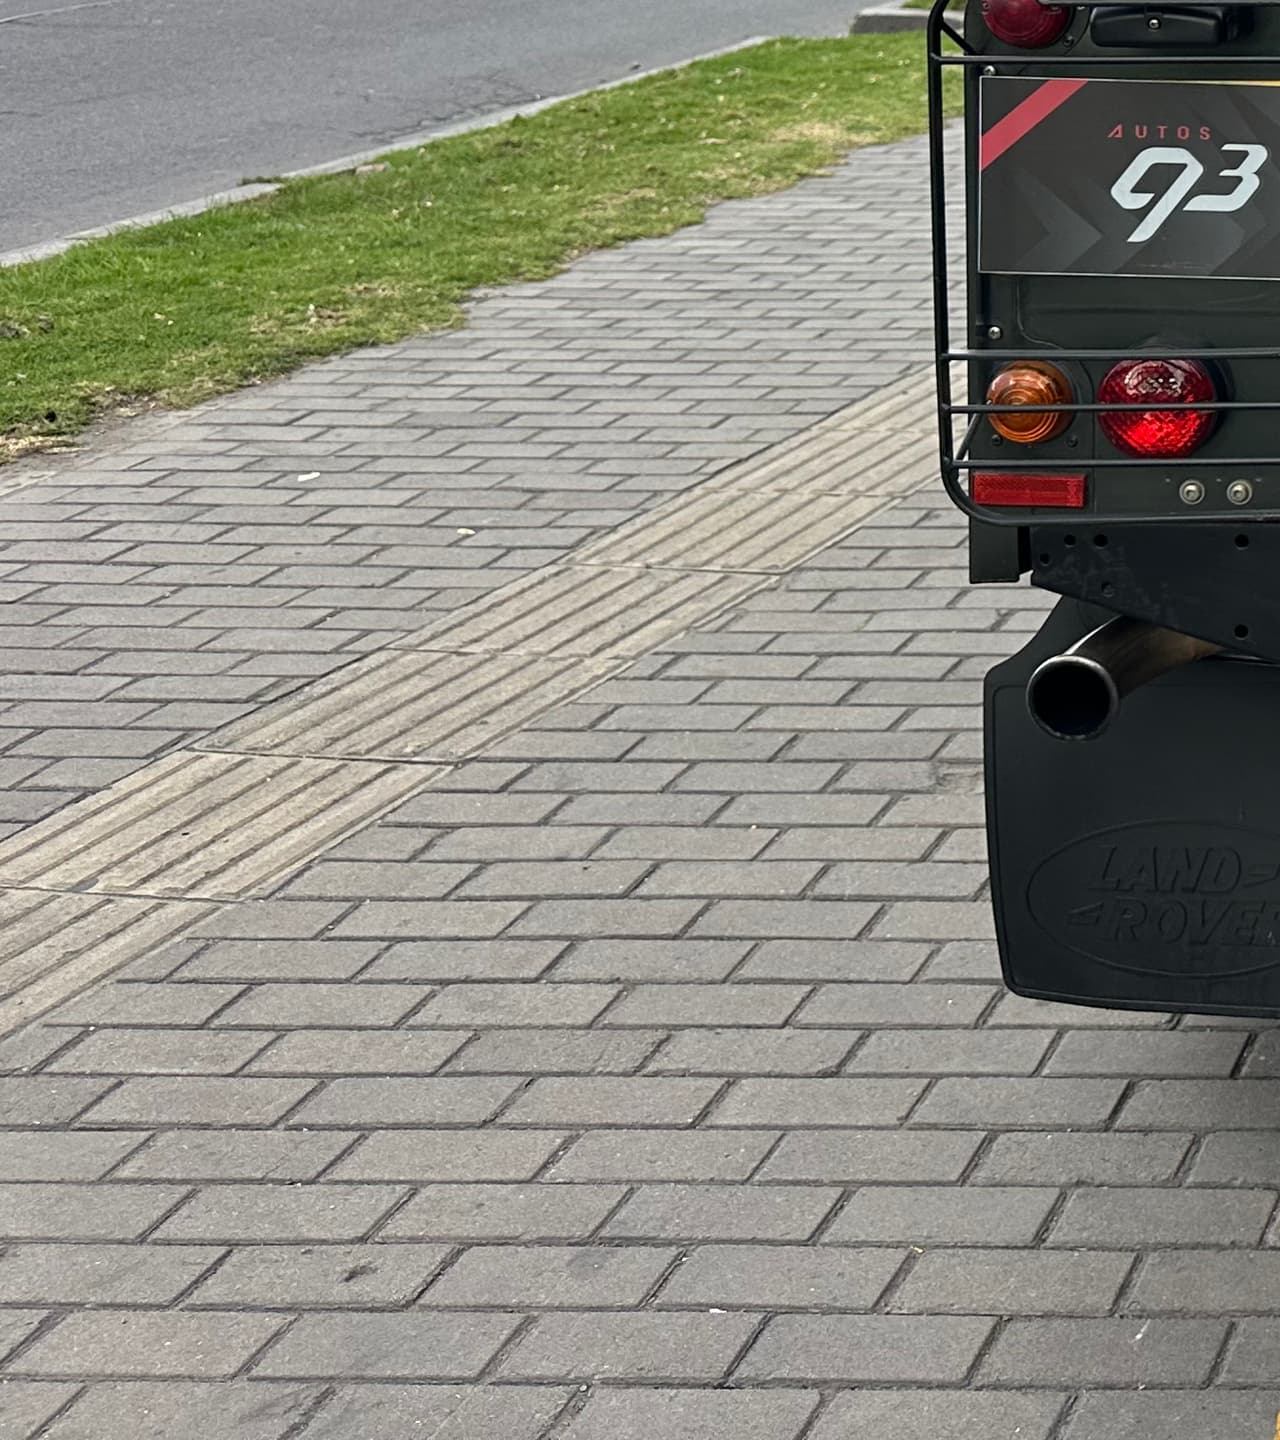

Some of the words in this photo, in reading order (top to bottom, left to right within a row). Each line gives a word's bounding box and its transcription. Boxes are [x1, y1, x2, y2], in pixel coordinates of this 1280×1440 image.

[1107, 123, 1212, 141] AUTOS
[1110, 143, 1269, 243] 93
[1090, 845, 1242, 895] LAND
